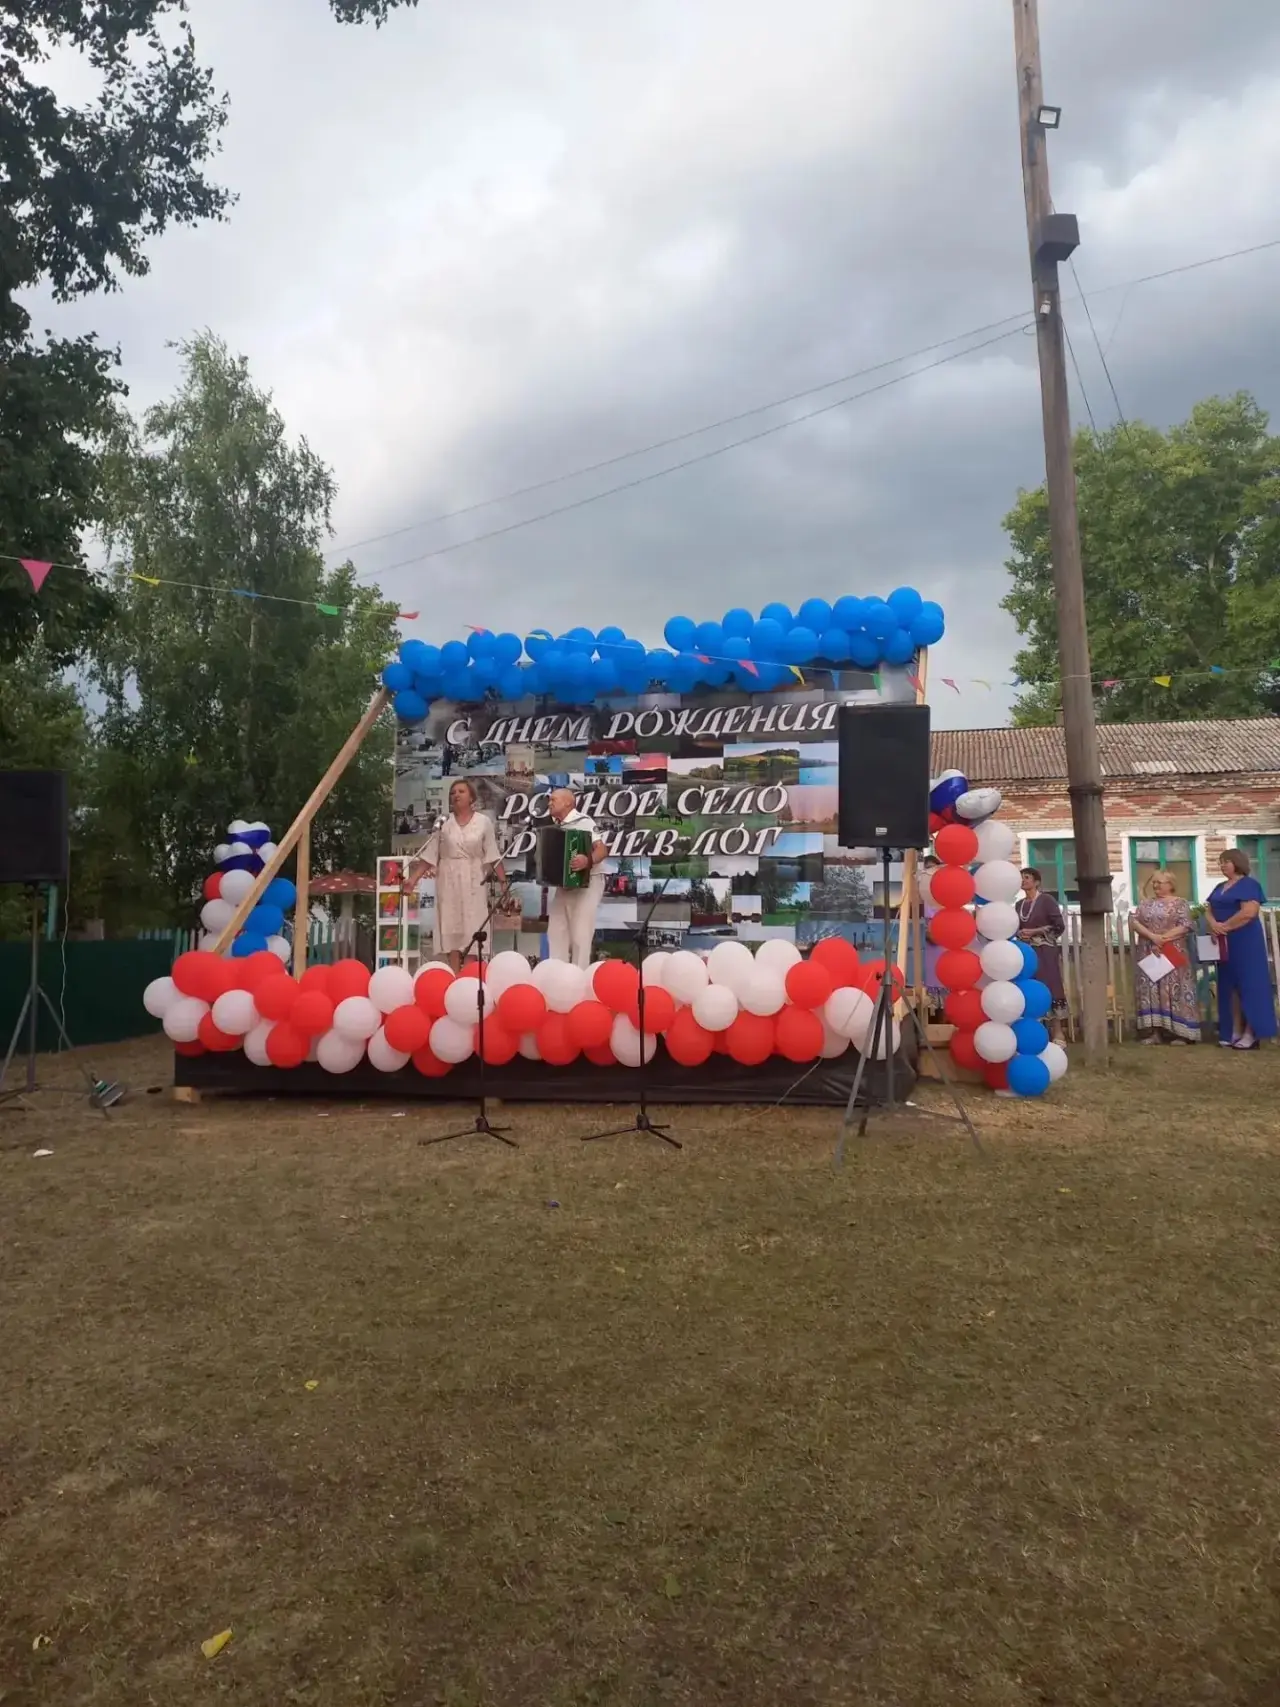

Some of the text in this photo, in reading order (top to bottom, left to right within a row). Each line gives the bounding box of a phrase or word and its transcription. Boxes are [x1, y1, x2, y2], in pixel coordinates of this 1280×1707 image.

[446, 701, 856, 747] С ДНЕМ РОЖДЕНИЯ
[677, 781, 788, 816] СЕЛО
[506, 826, 679, 858] РНЕВ
